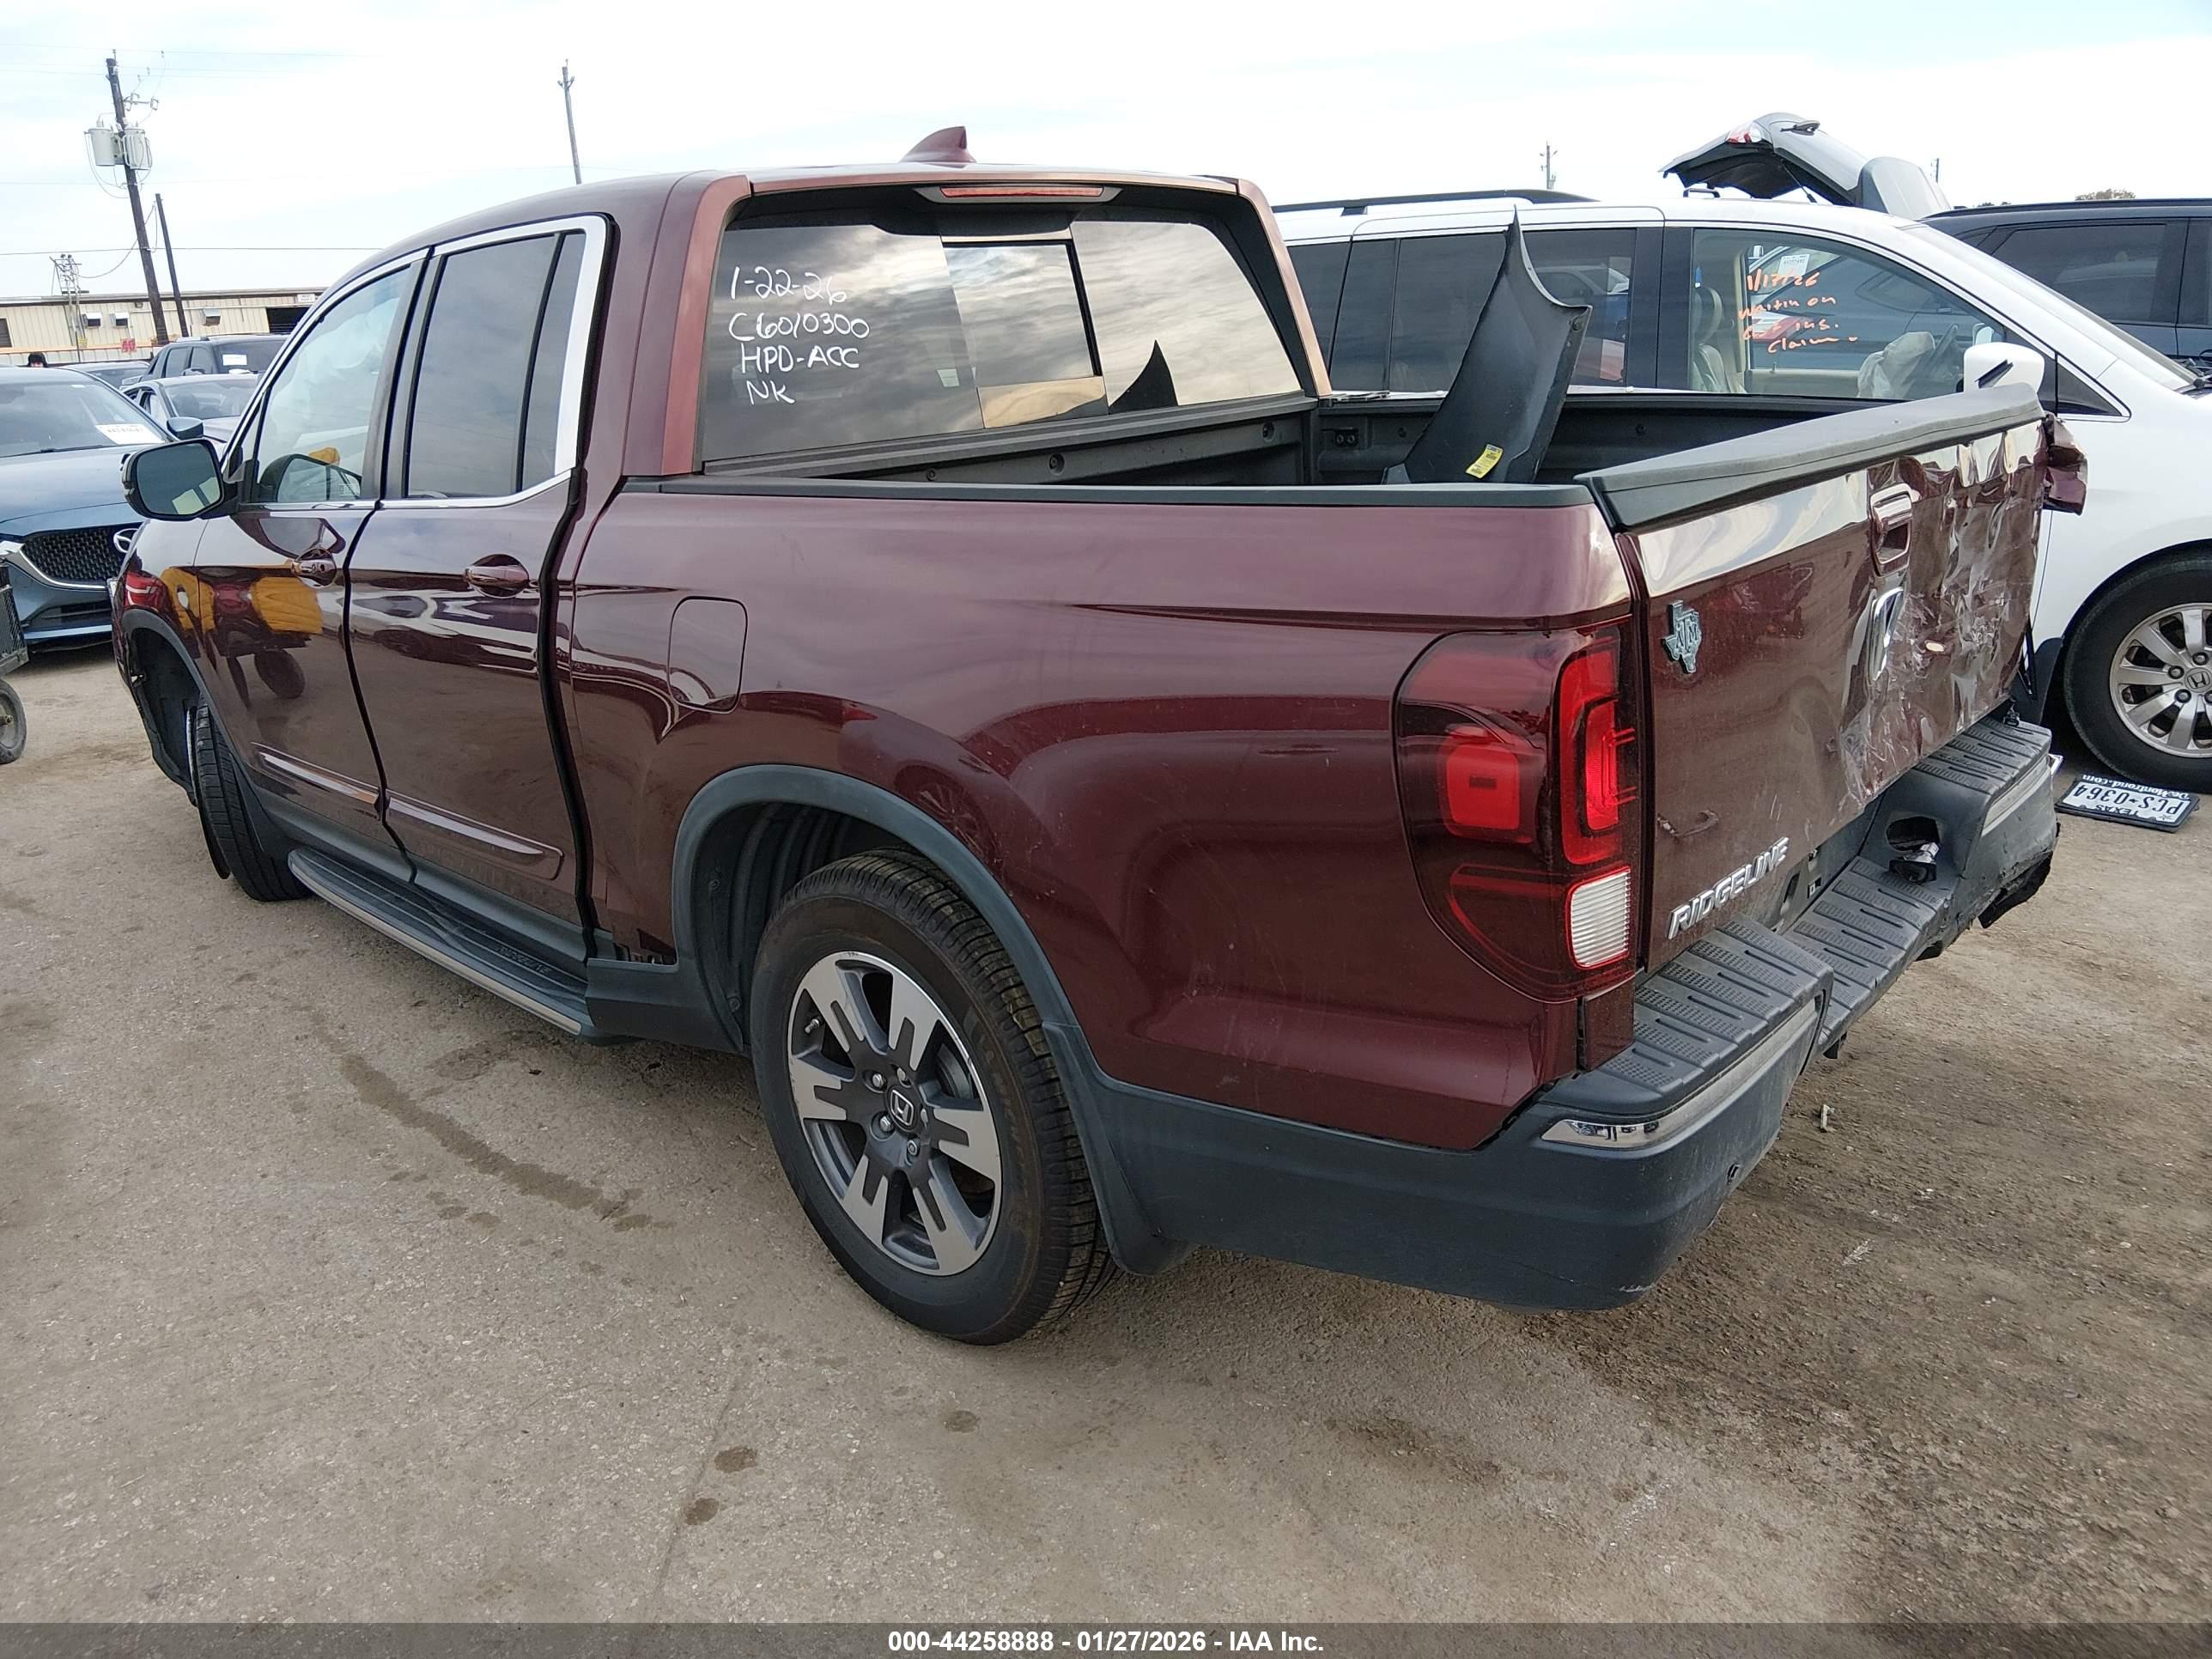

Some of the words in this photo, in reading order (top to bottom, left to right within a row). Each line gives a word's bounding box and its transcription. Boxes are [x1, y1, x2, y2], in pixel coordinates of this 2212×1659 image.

[731, 266, 847, 305] 1-22-26
[729, 313, 870, 341] C6010300
[741, 343, 859, 374] HPD-ACC
[2096, 804, 2139, 816] TEXAS
[1668, 836, 1790, 939] RIDGELINE
